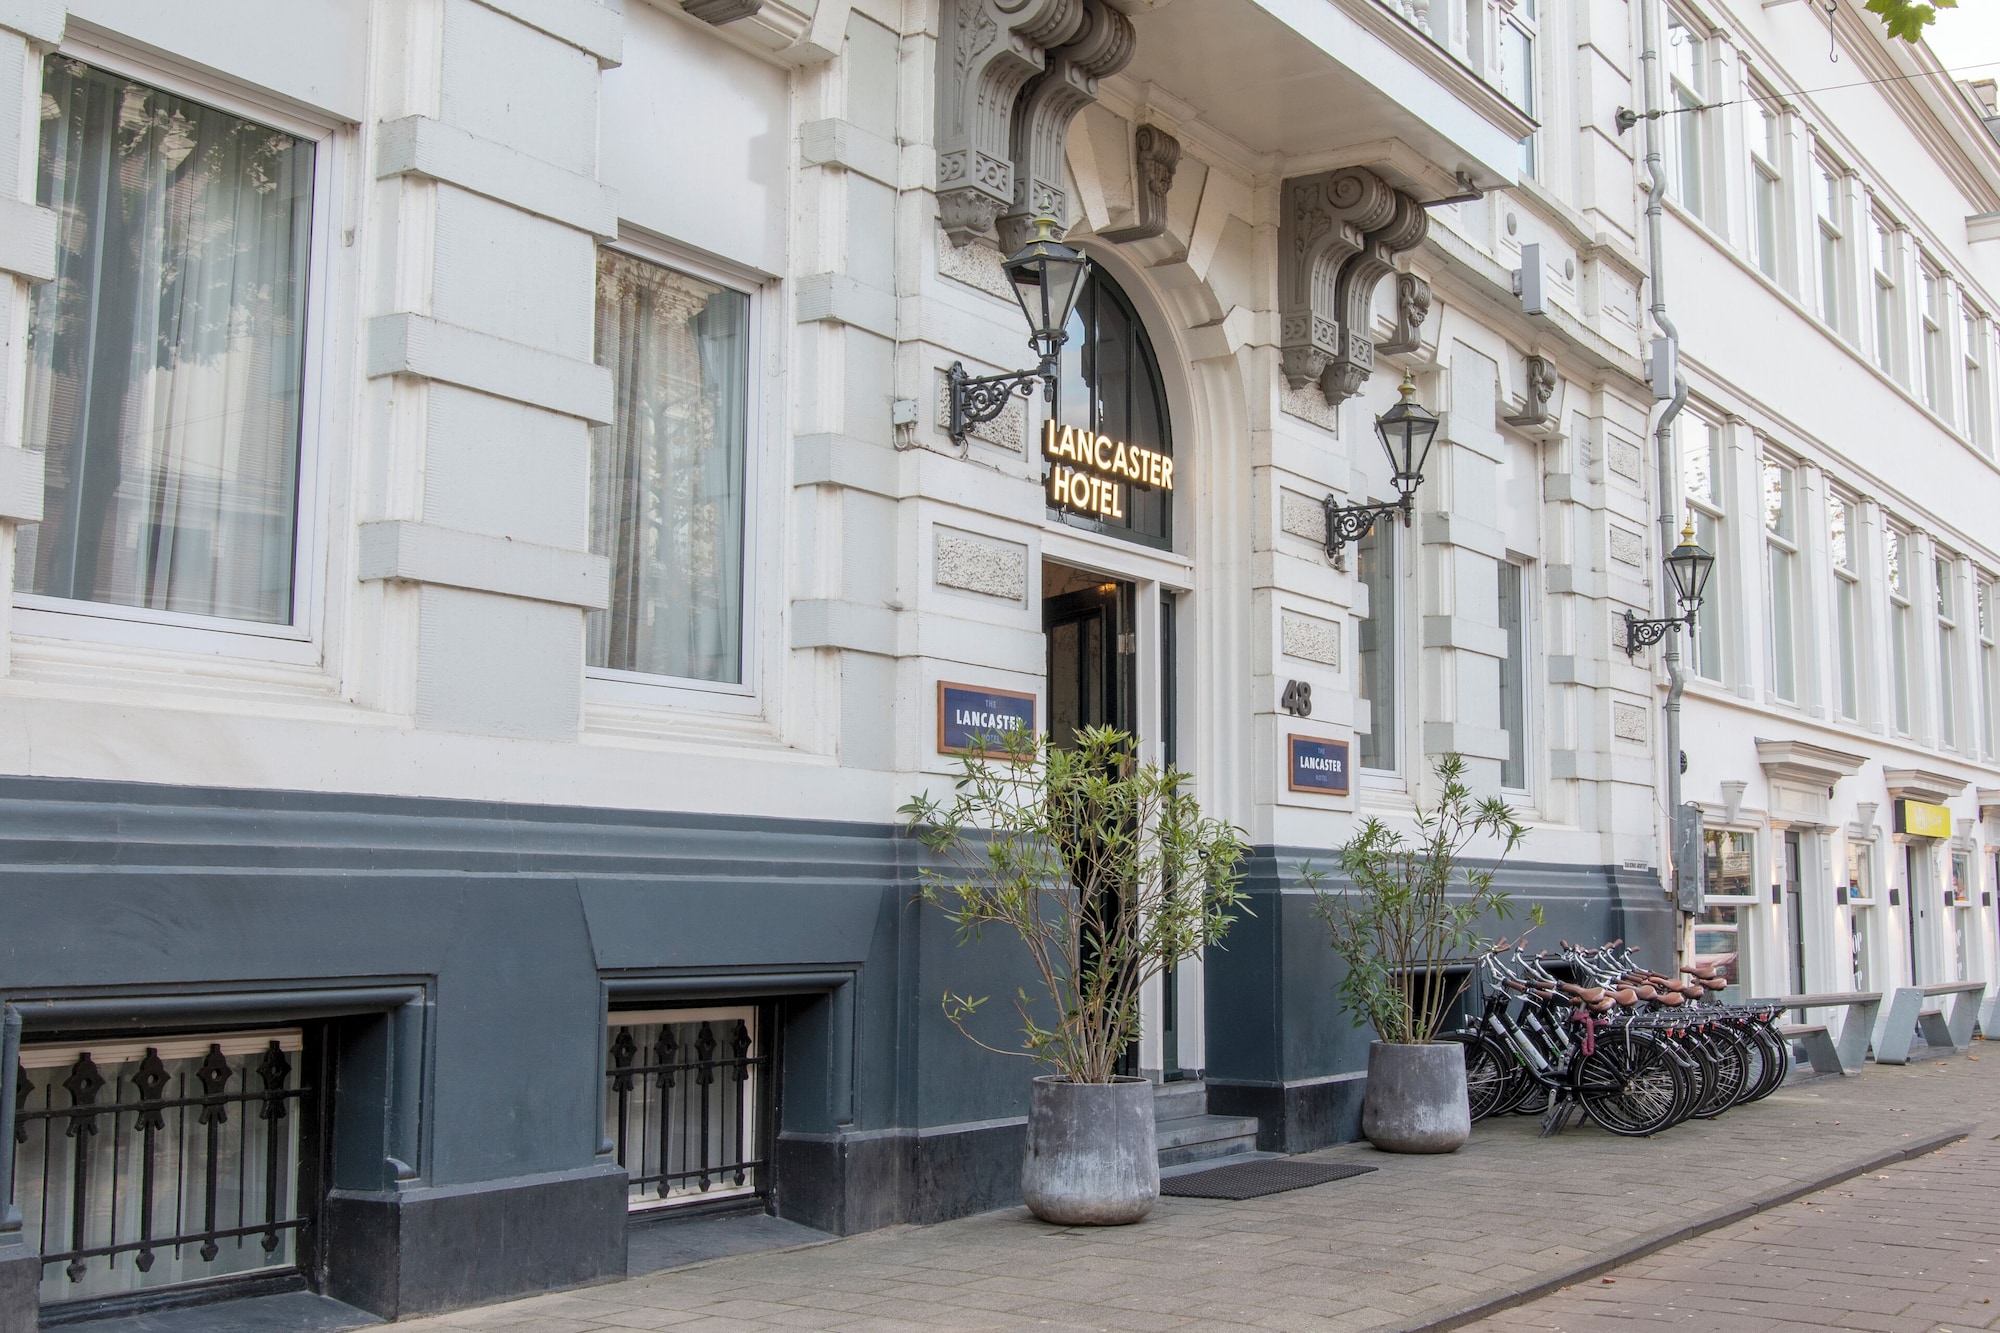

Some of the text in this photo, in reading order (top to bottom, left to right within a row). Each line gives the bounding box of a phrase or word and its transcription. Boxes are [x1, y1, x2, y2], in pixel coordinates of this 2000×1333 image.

[1048, 418, 1174, 490] LANCASTER
[1054, 465, 1122, 518] HOTEL
[985, 699, 997, 708] THE
[1282, 679, 1312, 717] 48
[1300, 756, 1342, 773] LANCASTER
